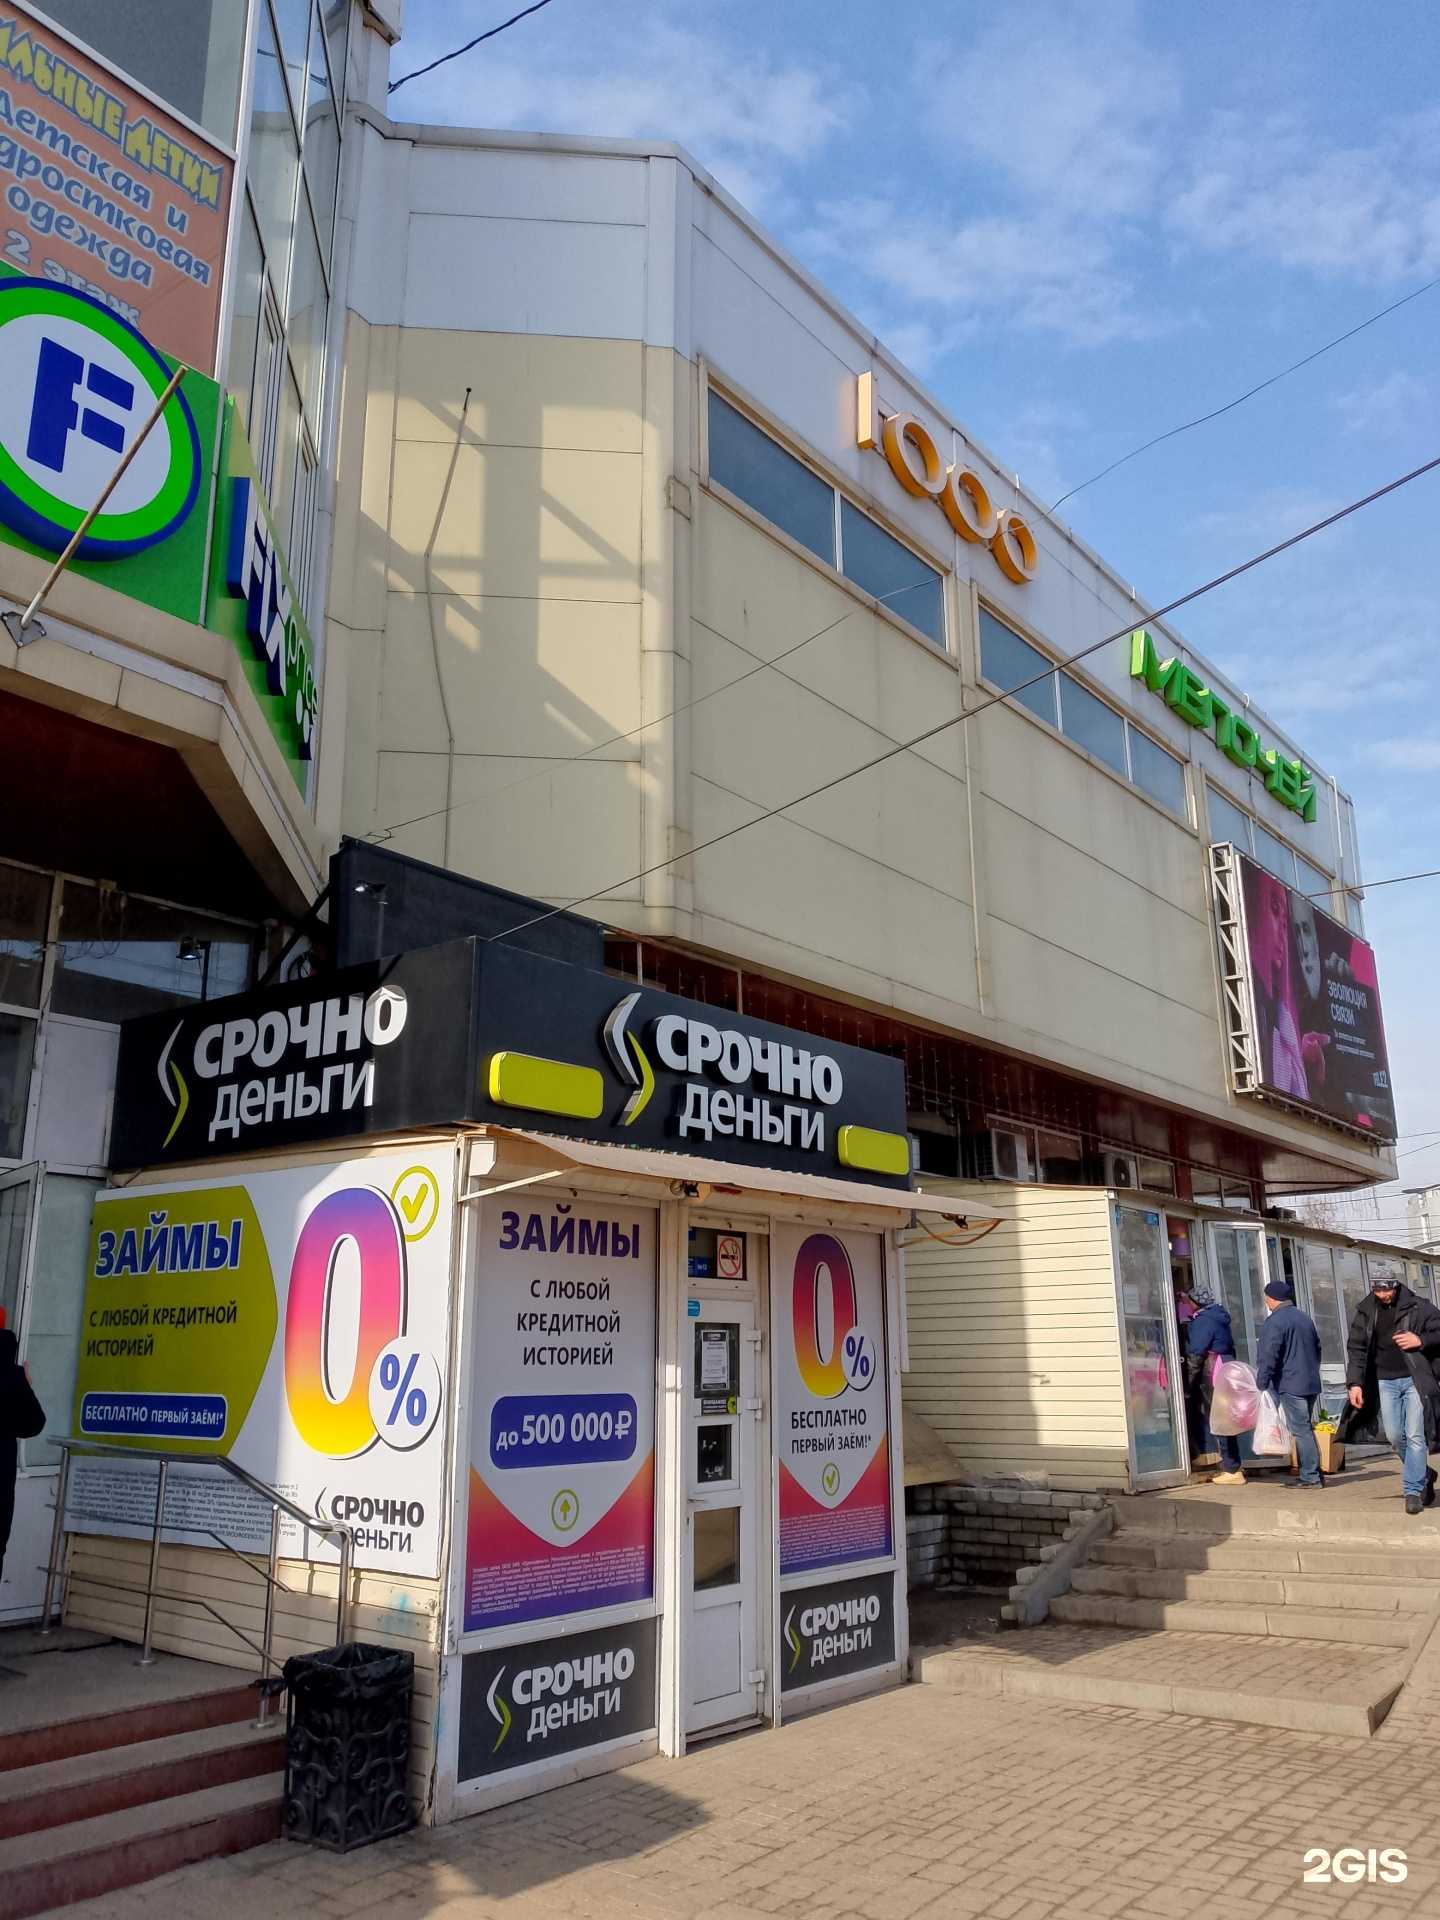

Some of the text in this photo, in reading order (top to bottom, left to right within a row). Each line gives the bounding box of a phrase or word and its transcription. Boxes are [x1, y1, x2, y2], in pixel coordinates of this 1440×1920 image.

[122, 113, 224, 212] ДЕТКИ
[6, 184, 154, 288] одежда
[165, 203, 188, 235] и
[5, 230, 31, 265] 2
[193, 984, 408, 1078] СРОЧНО
[655, 1014, 843, 1105] СРОЧНО
[94, 1210, 243, 1278] ЗАЙМЫ
[499, 1203, 640, 1259] ЗАЙМЫ
[530, 1278, 611, 1300] С ЛЮБОЙ
[99, 1304, 149, 1327] ЛЮБОЙ
[152, 1300, 238, 1329] КРЕДИТНОЙ
[517, 1310, 621, 1336] КРЕДИТНОЙ
[86, 1334, 155, 1357] ИСТОРИЕЙ
[523, 1342, 613, 1366] ИСТОРИЕЙ
[85, 1405, 148, 1422] БЕСПЛАТНО
[151, 1408, 189, 1424] ПЕРВЫЙ
[791, 1408, 867, 1430] БЕСПЛАТНО
[496, 1428, 519, 1451] до
[521, 1413, 565, 1446] 500
[791, 1432, 835, 1454] ПЕРВЫЙ
[331, 1494, 425, 1528] СРОЧНО
[349, 1526, 413, 1554] еньги
[800, 1595, 880, 1638] СРОЧНО
[511, 1648, 635, 1705] СРОЧНО
